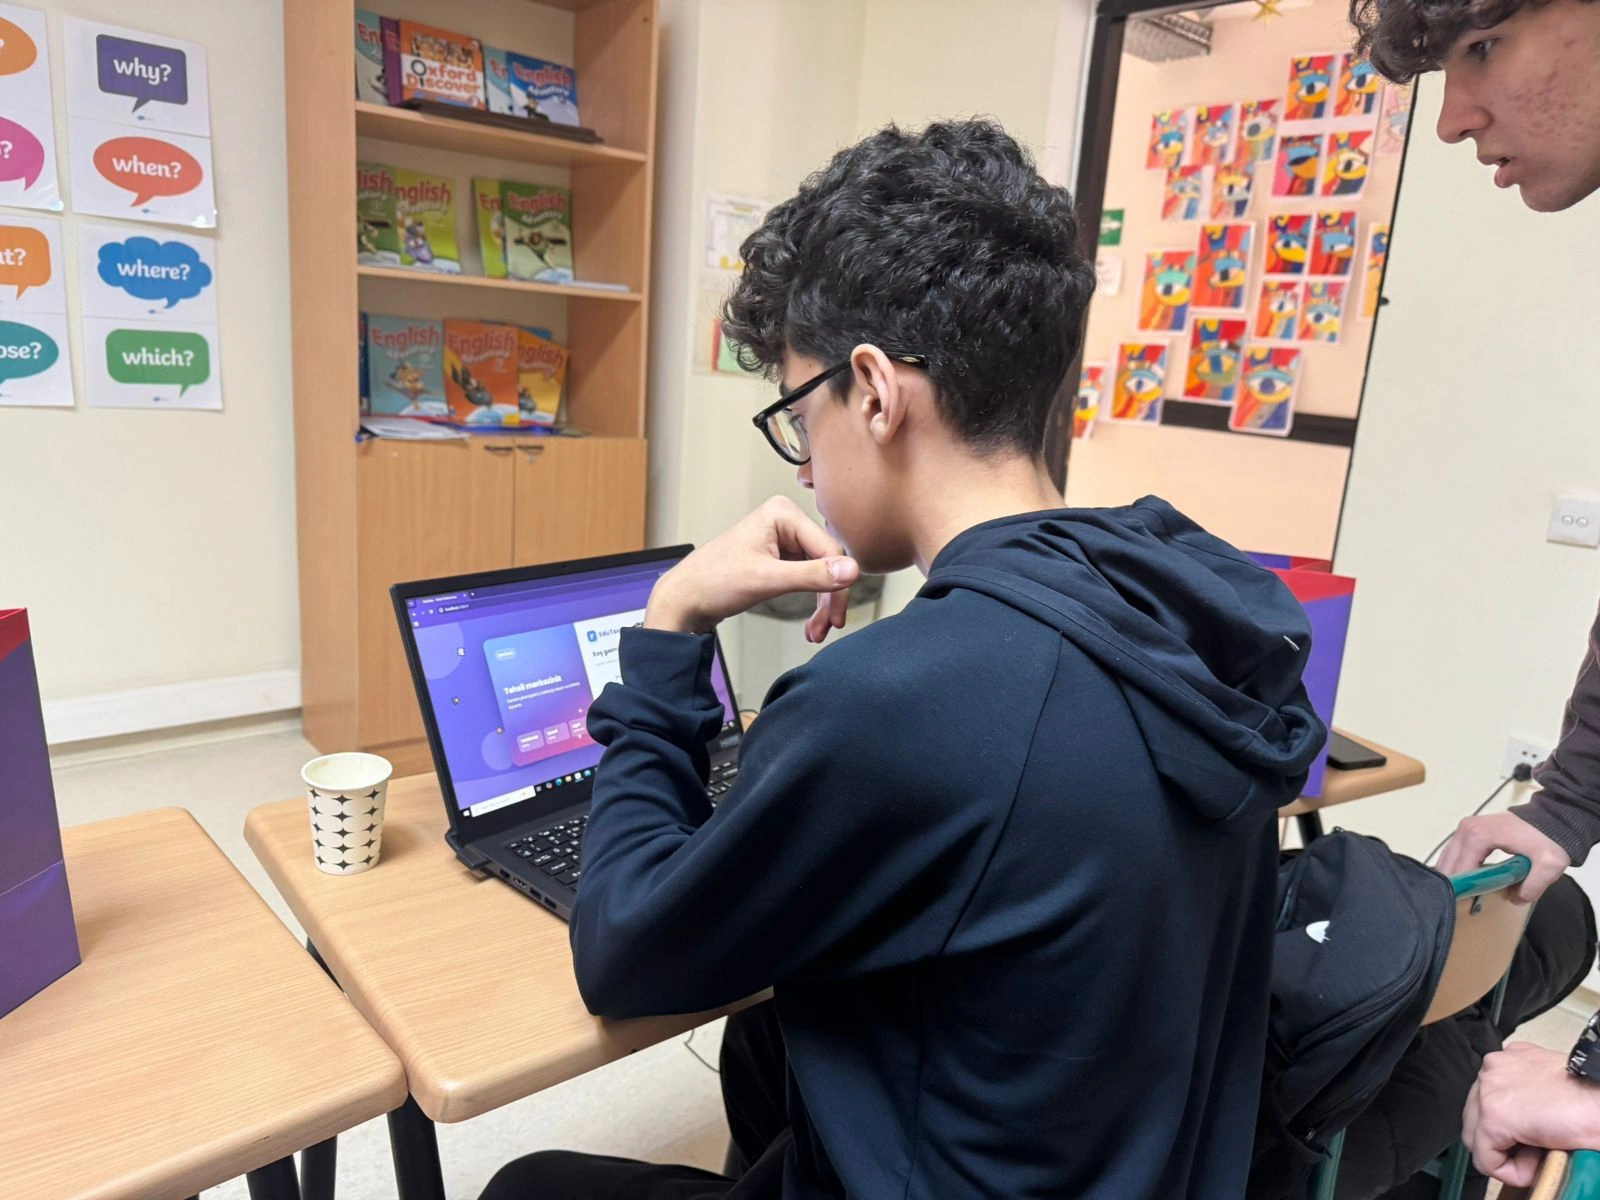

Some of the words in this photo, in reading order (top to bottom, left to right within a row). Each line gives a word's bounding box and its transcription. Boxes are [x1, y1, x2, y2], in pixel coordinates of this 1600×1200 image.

[113, 57, 172, 86] why?
[411, 59, 477, 82] Oxford
[512, 62, 573, 88] English
[406, 73, 481, 94] Discover
[112, 154, 182, 179] when?
[357, 169, 393, 193] lish
[395, 180, 452, 206] nglish
[507, 190, 565, 215] English
[117, 258, 191, 281] where?
[371, 324, 440, 352] English
[447, 331, 515, 357] English
[0, 341, 42, 360] ose?
[122, 346, 194, 367] which?
[518, 344, 563, 368] nglish
